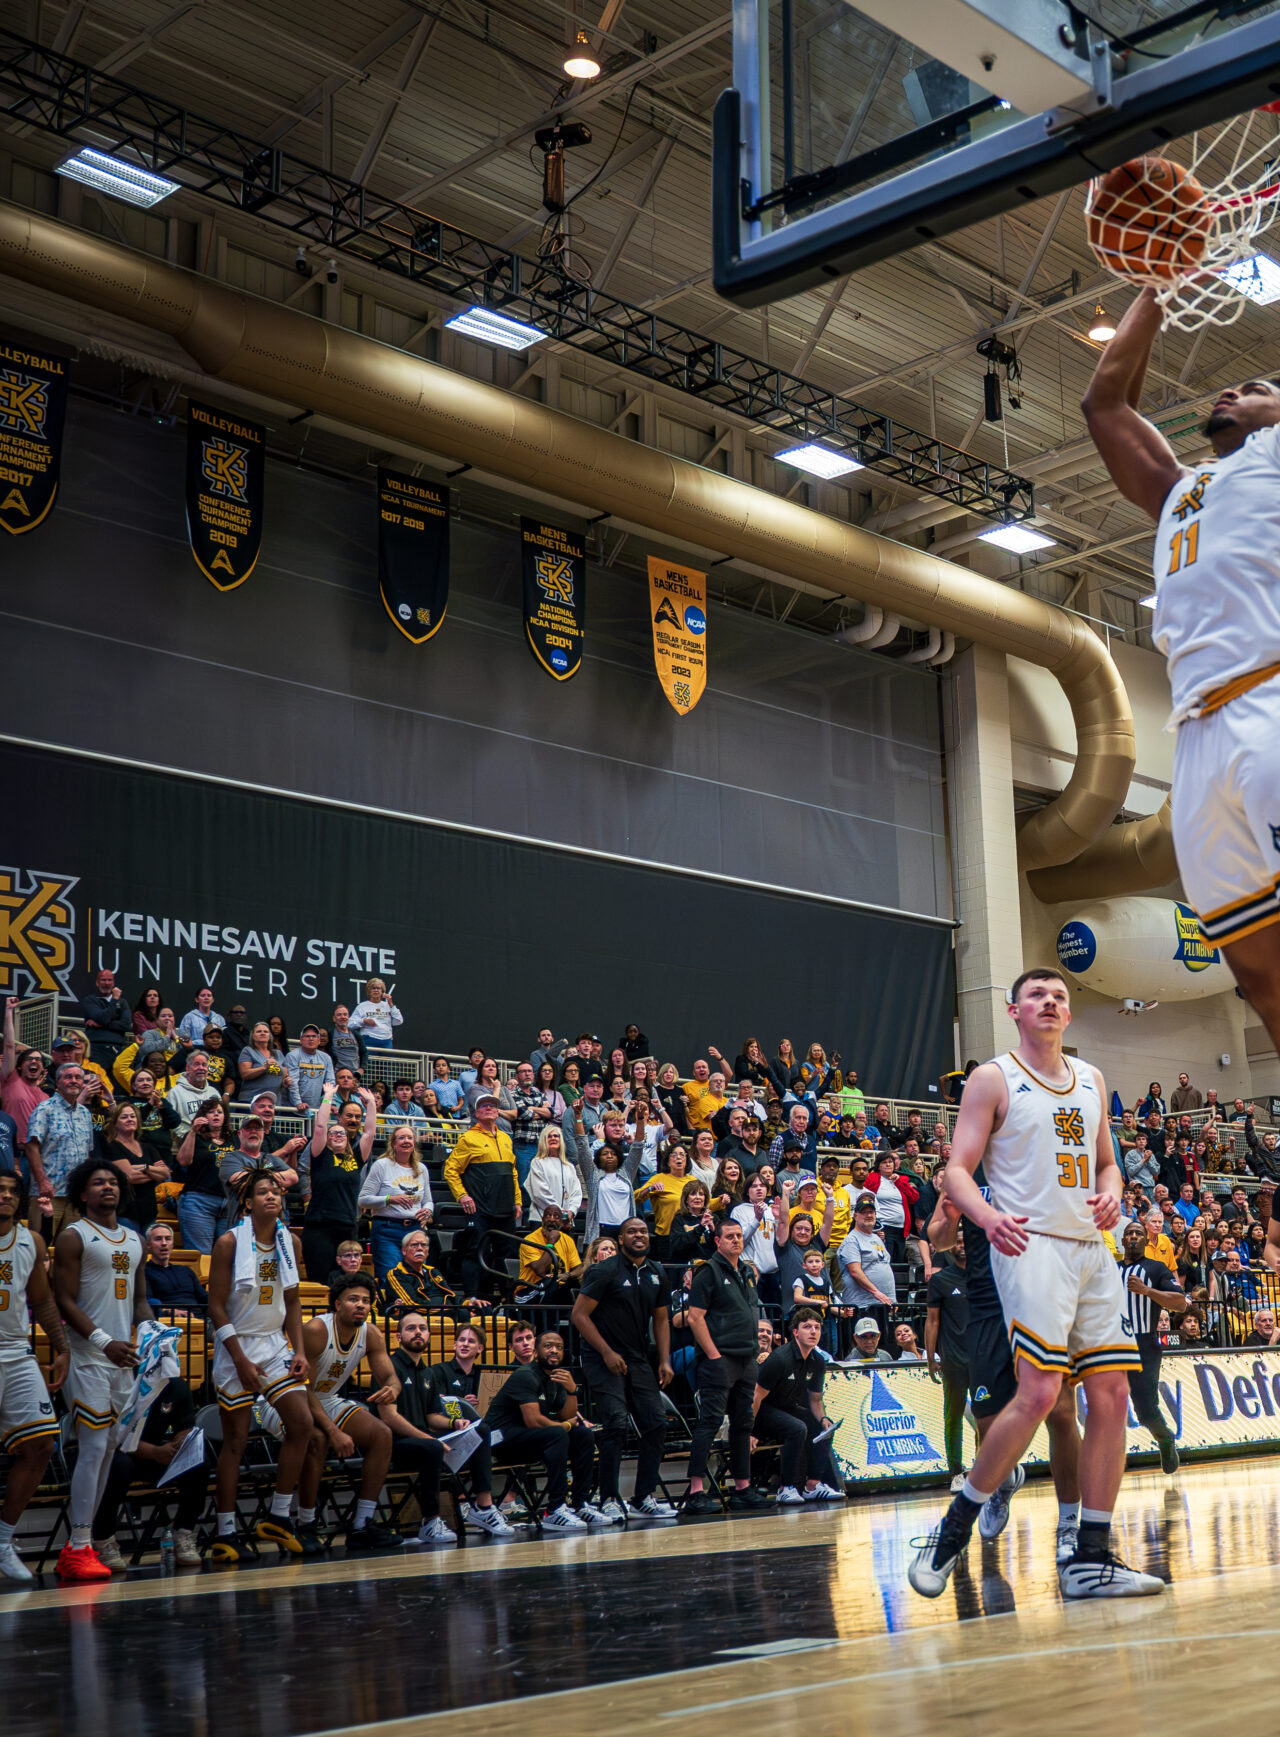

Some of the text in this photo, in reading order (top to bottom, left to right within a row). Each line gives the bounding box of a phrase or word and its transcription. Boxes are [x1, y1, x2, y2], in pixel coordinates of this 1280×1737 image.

[191, 407, 261, 443] VOLLEYBALL
[386, 478, 441, 502] VOLLEYBALL
[198, 501, 252, 527] TOURNAMENT
[199, 493, 252, 518] CONFERENCE
[403, 499, 446, 518] TOURNAMENT
[201, 513, 249, 536] CHAMPIONS
[403, 516, 425, 531] 2019
[209, 529, 238, 549] 2019
[540, 525, 568, 543] MEN'S
[523, 531, 584, 558] BASKETBALL
[1166, 519, 1200, 577] 11
[666, 569, 689, 586] MEN'S
[653, 577, 703, 601] BASKETBALL
[537, 609, 577, 627] CHAMPIONS
[539, 602, 575, 619] NATIONAL
[529, 616, 550, 630] NCAA
[551, 622, 579, 637] DIVISION
[687, 617, 706, 630] NCAA
[545, 633, 573, 651] 2004
[680, 637, 701, 650] SEASON
[551, 657, 568, 667] NCAA
[672, 651, 687, 663] FIRST
[671, 664, 691, 678] 2023
[99, 908, 397, 975] KENNESAW STATE
[1057, 938, 1084, 951] Honest
[1062, 931, 1075, 941] The
[1058, 947, 1089, 960] Plumber
[98, 946, 397, 1005] UNIVERSIT
[1055, 1152, 1089, 1188] 31
[114, 1278, 127, 1300] 6
[258, 1285, 273, 1305] 2
[1167, 1334, 1180, 1346] POSS
[866, 1413, 915, 1434] Superior
[876, 1437, 926, 1457] PLUMBING
